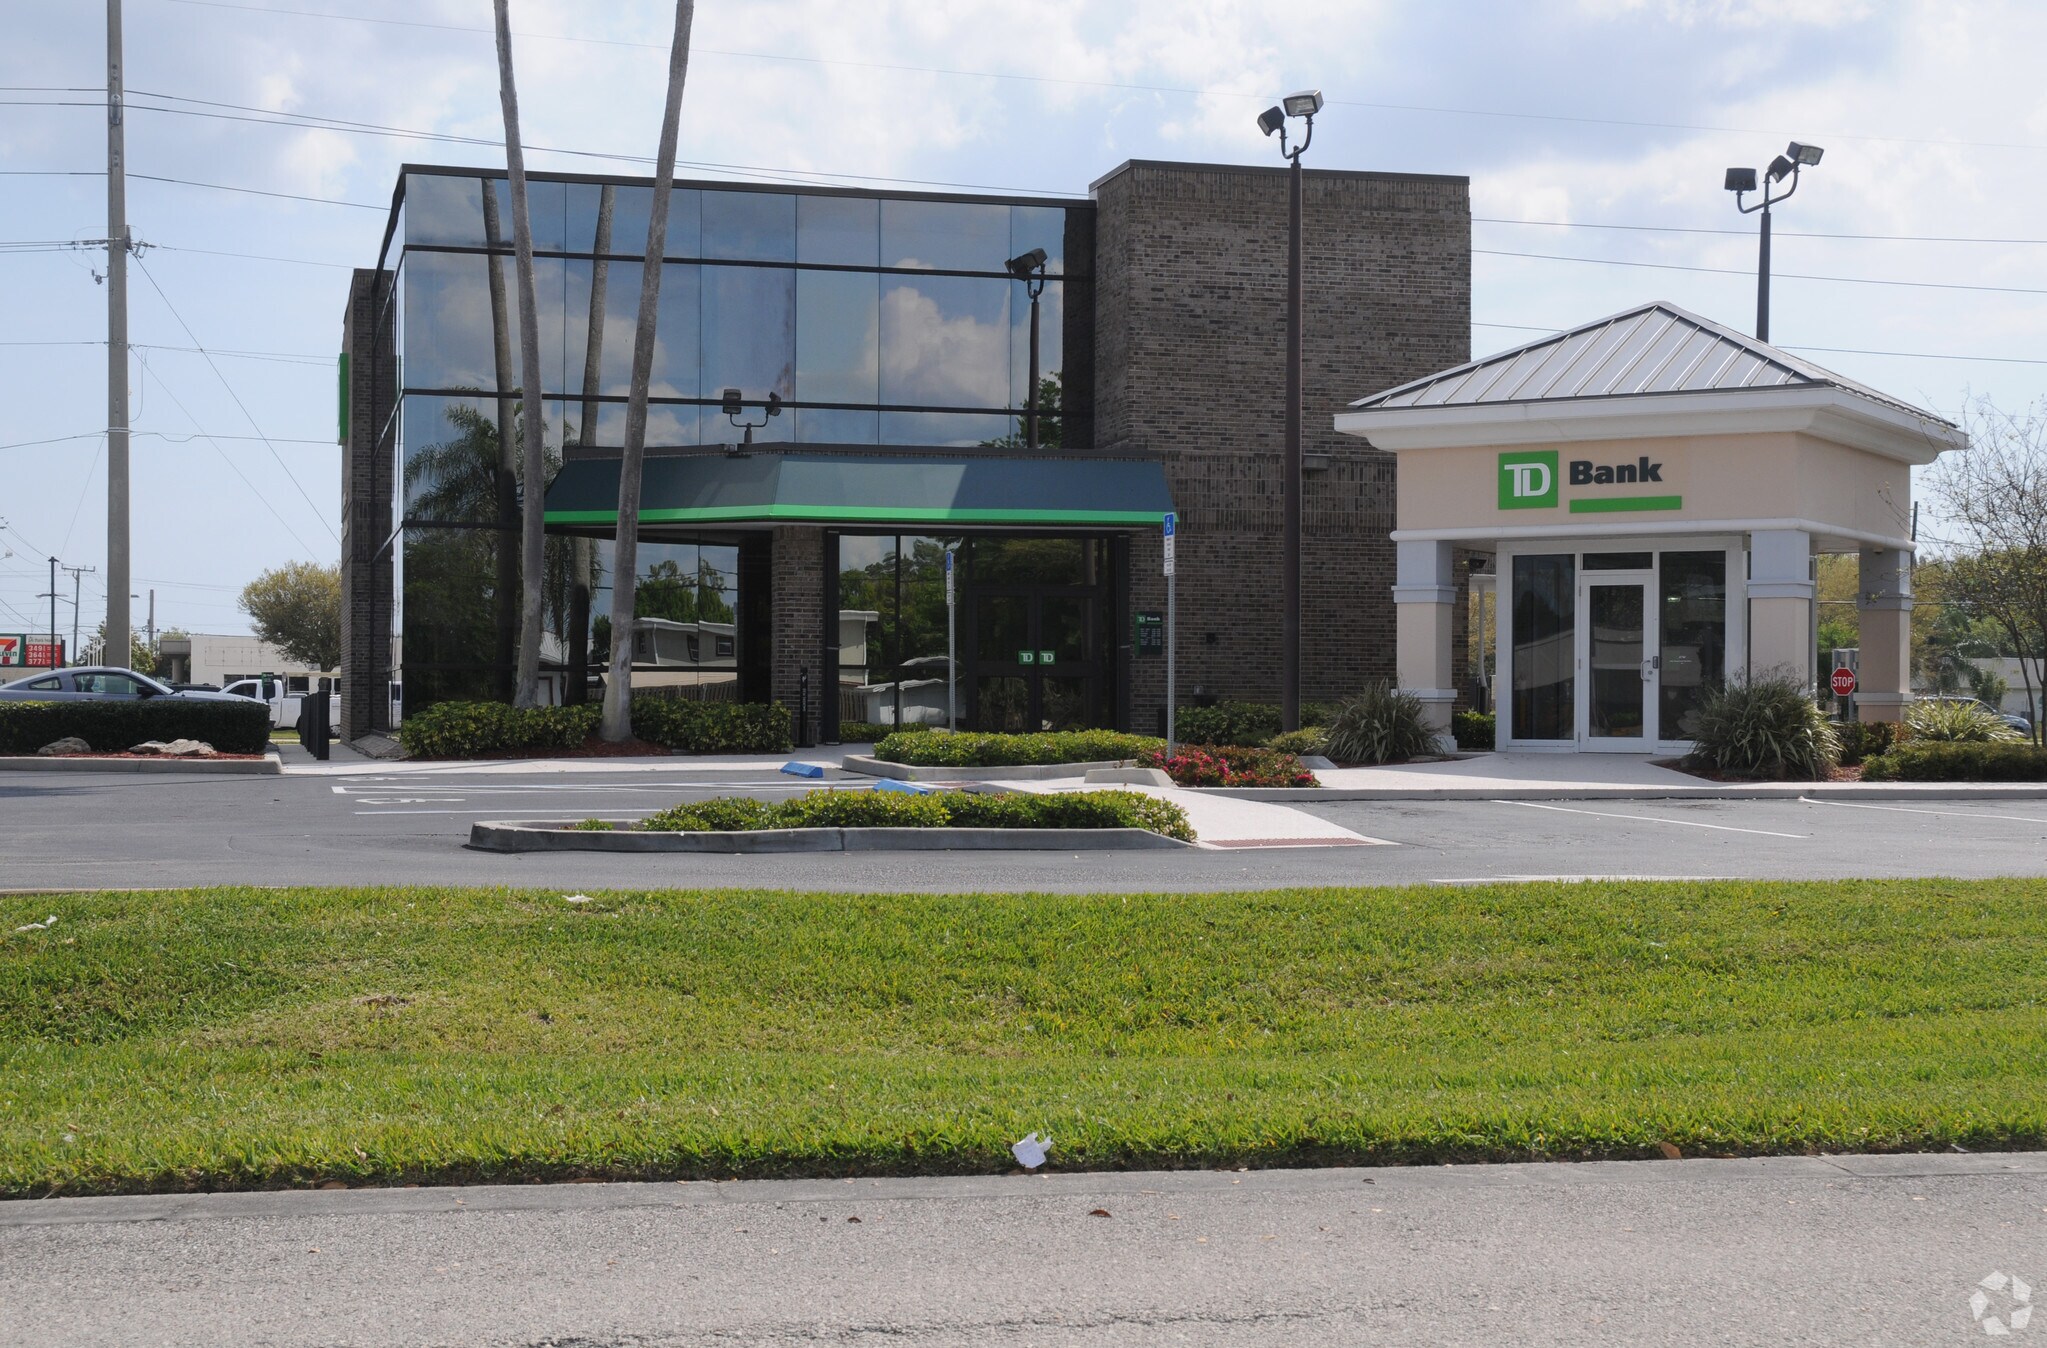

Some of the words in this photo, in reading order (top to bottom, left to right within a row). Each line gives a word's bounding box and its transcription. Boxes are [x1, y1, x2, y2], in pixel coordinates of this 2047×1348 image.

[1504, 463, 1551, 497] TD
[1569, 456, 1663, 485] Bank
[1020, 652, 1034, 662] TD
[1041, 652, 1054, 663] TD
[1832, 676, 1853, 687] STOP
